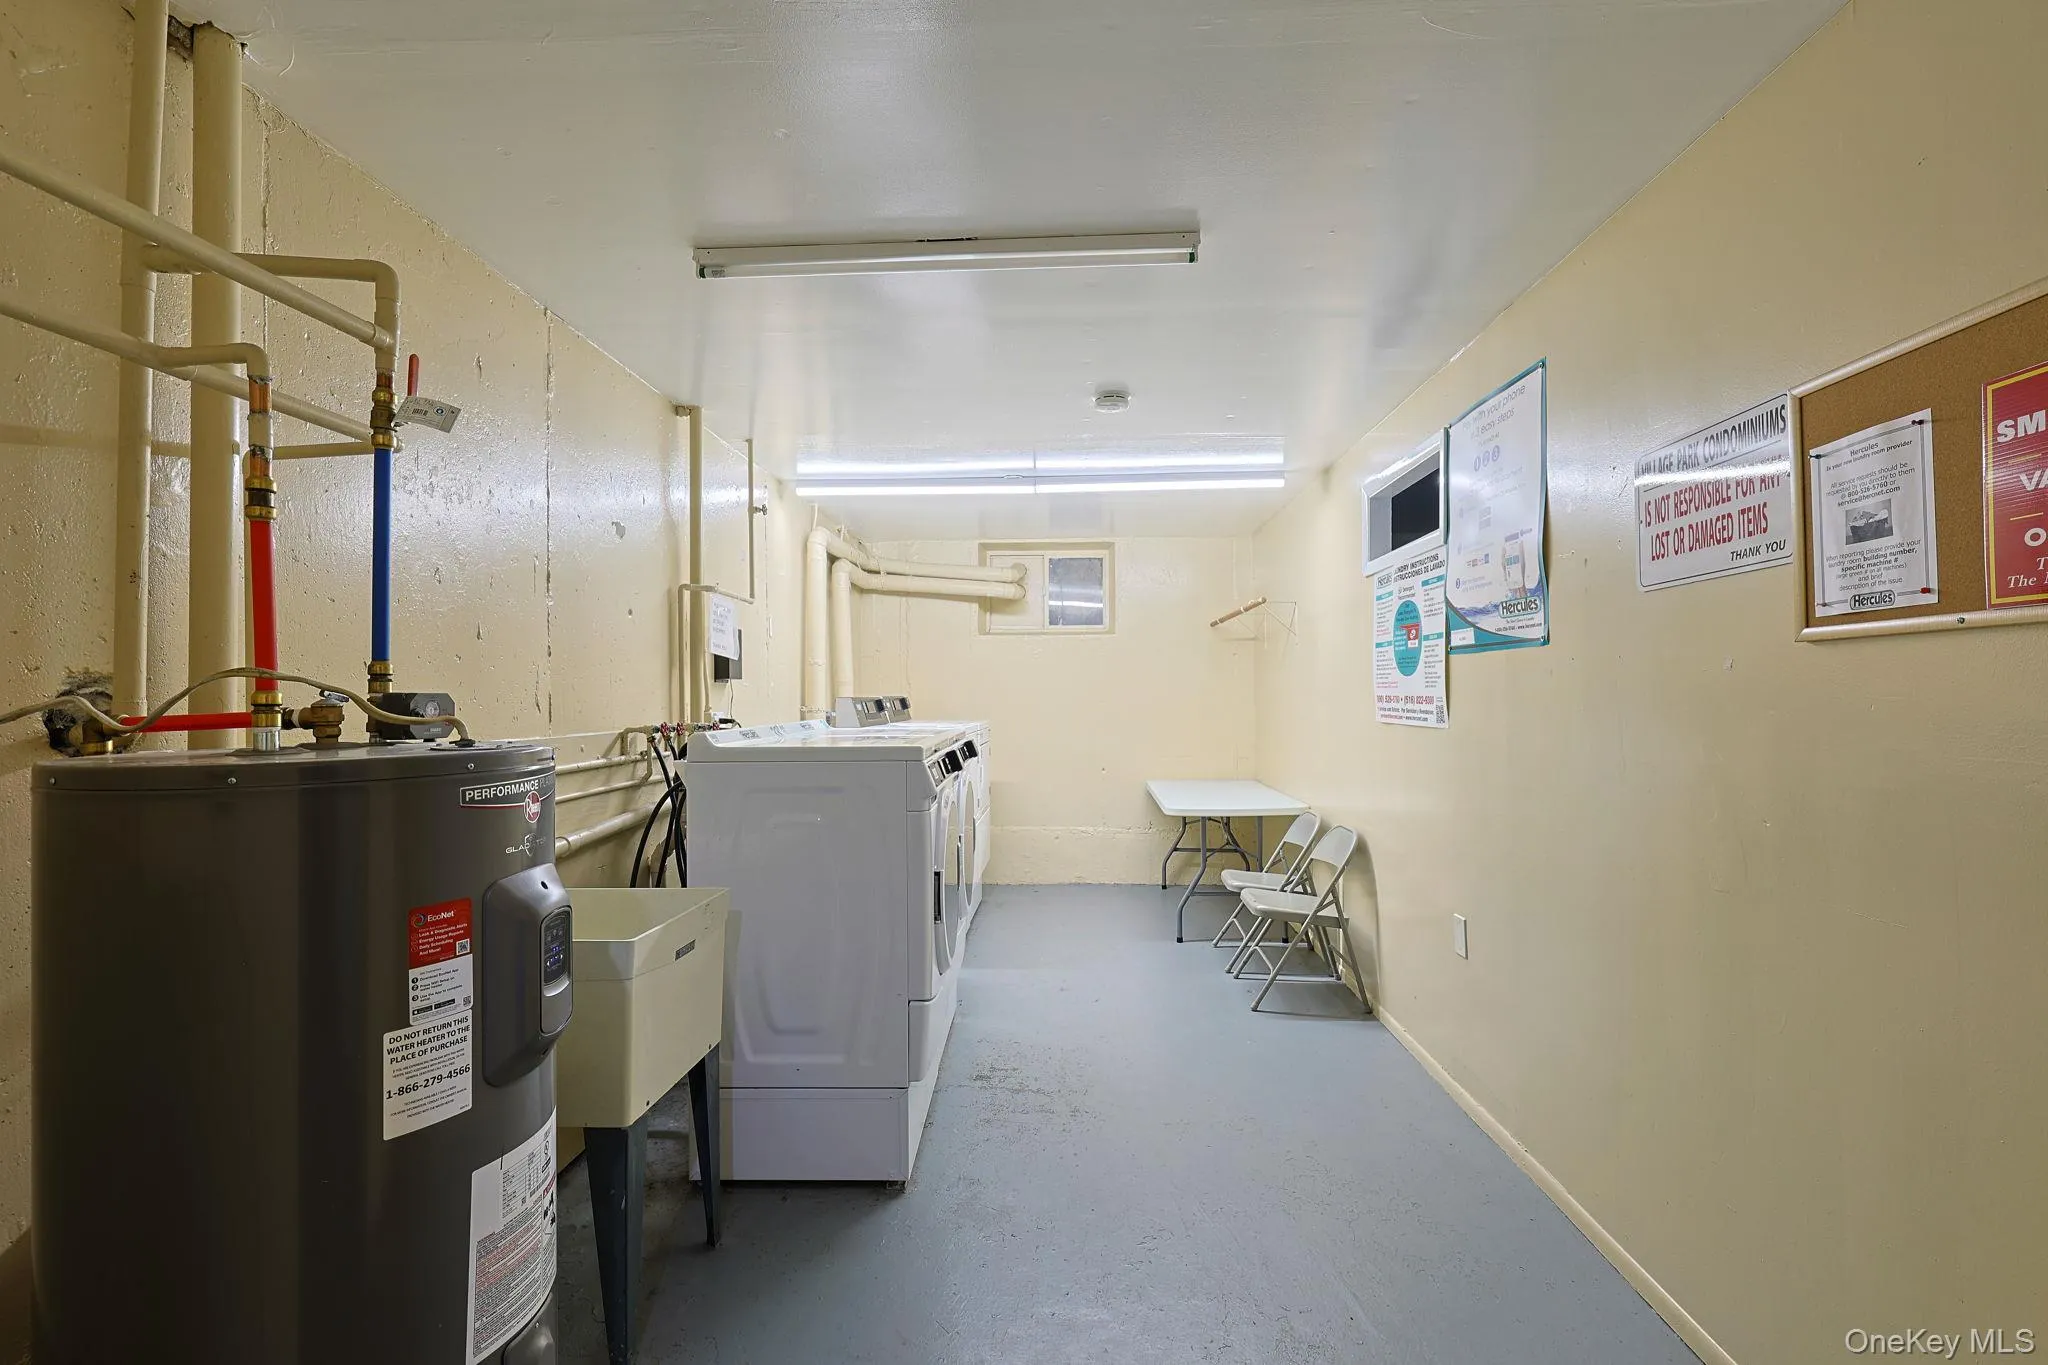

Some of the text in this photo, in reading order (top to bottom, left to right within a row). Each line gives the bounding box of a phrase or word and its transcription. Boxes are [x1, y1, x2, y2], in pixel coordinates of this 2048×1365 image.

[1503, 385, 1526, 407] phone
[1481, 420, 1496, 434] easy
[1677, 441, 1700, 470] PARK
[1703, 404, 1787, 463] CONDOMINIUMS
[1850, 442, 1878, 456] Hercules
[1853, 453, 1870, 462] laundry
[1872, 448, 1885, 457] room
[1887, 440, 1912, 452] provider
[1826, 484, 1850, 496] requested
[1852, 483, 1858, 492] by
[1868, 474, 1888, 485] directly
[1898, 468, 1915, 476] them
[1839, 478, 1855, 487] service
[1856, 471, 1876, 483] requests
[1879, 464, 1897, 473] should
[1644, 499, 1651, 528] IS
[1655, 493, 1670, 525] NOT
[1674, 479, 1732, 519] RESPONSIBLE
[1652, 501, 1768, 561] LOST OR DAMAGED ITEMS
[1730, 539, 1786, 561] THANK YOU
[1840, 549, 1864, 560] reporting
[1866, 546, 1883, 555] please
[1884, 541, 1904, 552] provide
[1906, 540, 1920, 548] your
[1863, 553, 1887, 562] building
[1889, 547, 1917, 557] number,
[1410, 553, 1439, 569] INSTRUCTIONS
[1430, 560, 1445, 571] LAVADO
[1841, 563, 1865, 573] specific
[1867, 559, 1892, 568] machine
[1840, 582, 1869, 591] description
[2008, 575, 2036, 588] The
[1502, 598, 1538, 615] Hercules
[1854, 592, 1892, 608] Hercules
[465, 780, 538, 801] PERFORMANCE
[428, 911, 454, 922] EcoNet
[387, 1043, 415, 1055] WATER
[416, 1033, 445, 1047] HEATER
[457, 1025, 470, 1034] THE
[389, 1016, 468, 1044] DO NOT RETURN THIS
[390, 1052, 416, 1064] PLACE
[418, 1048, 428, 1056] OF
[430, 1035, 468, 1053] PURCHASE
[386, 1064, 470, 1100] 1-866-279-4566
